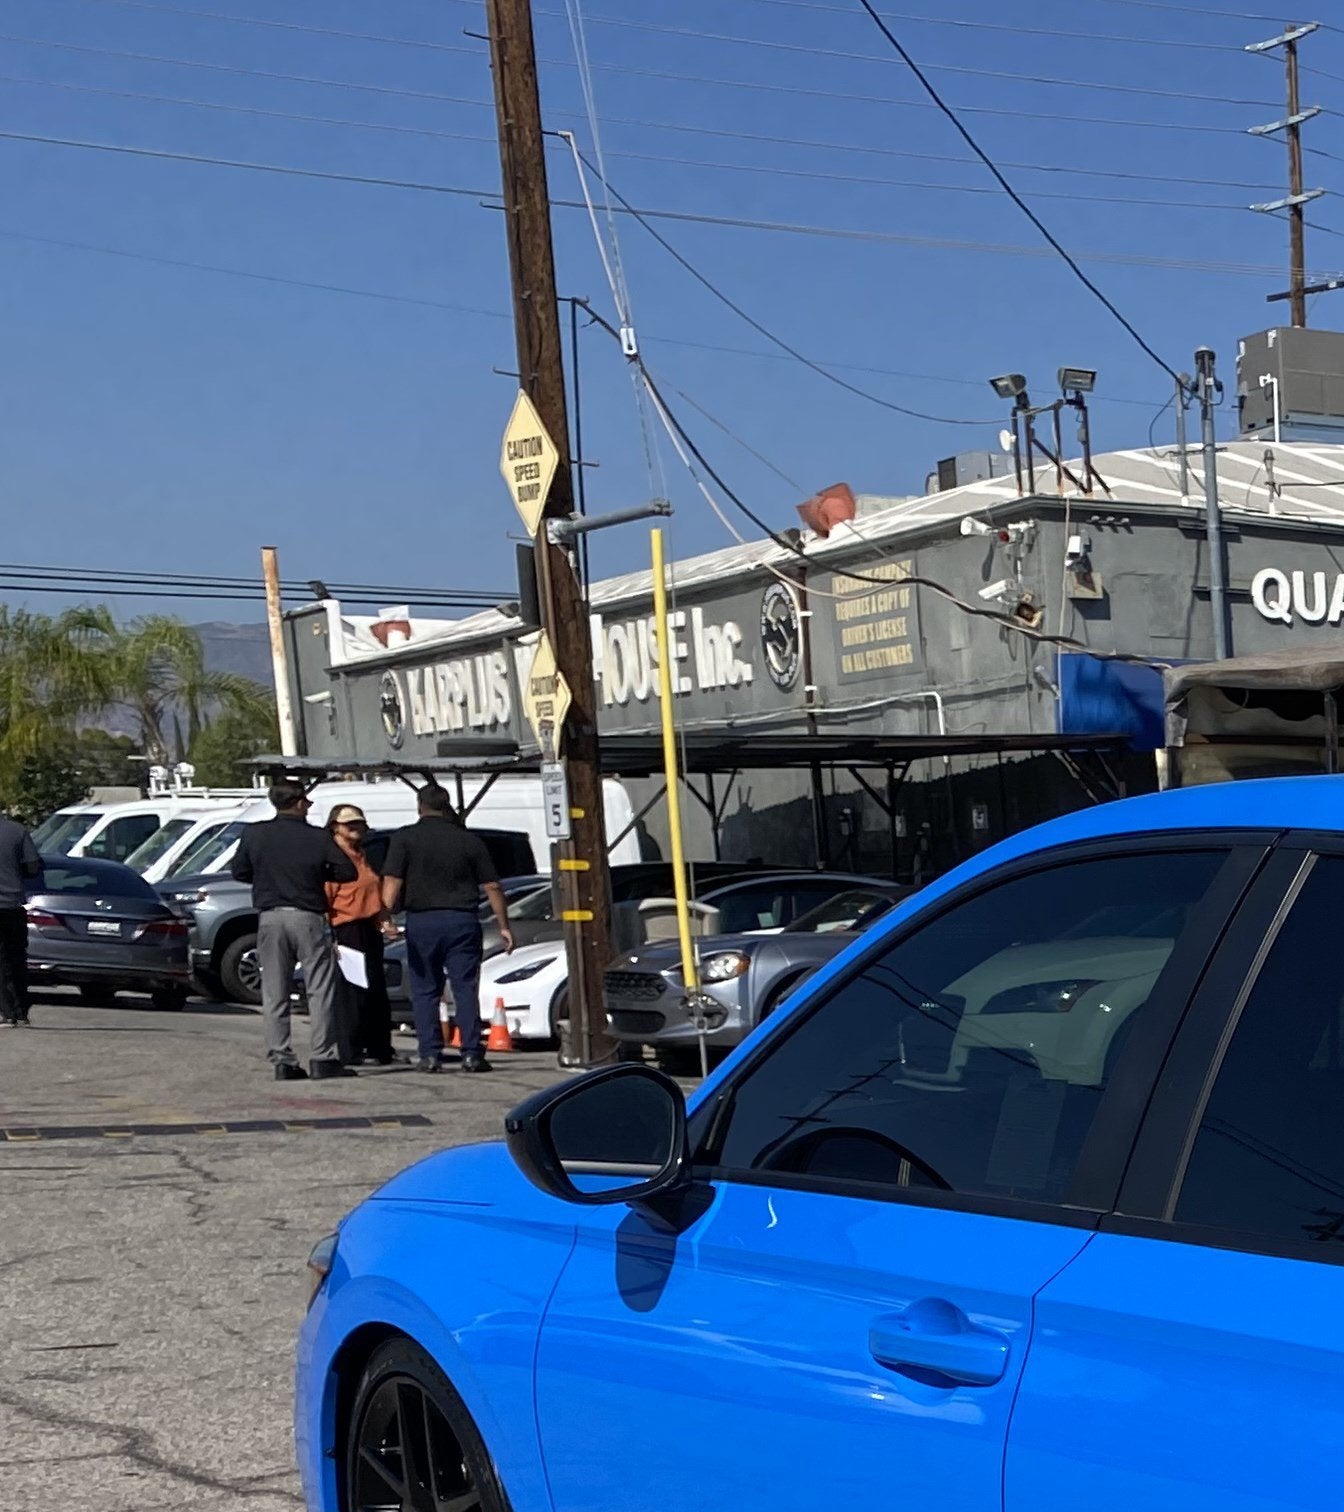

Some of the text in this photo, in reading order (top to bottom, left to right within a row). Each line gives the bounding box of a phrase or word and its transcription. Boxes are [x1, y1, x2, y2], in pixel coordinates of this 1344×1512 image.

[506, 435, 543, 461] CAUTION
[514, 462, 540, 482] SPEED
[406, 651, 512, 735] KARPLUS
[691, 607, 753, 688] Inc.
[551, 804, 562, 827] 5
